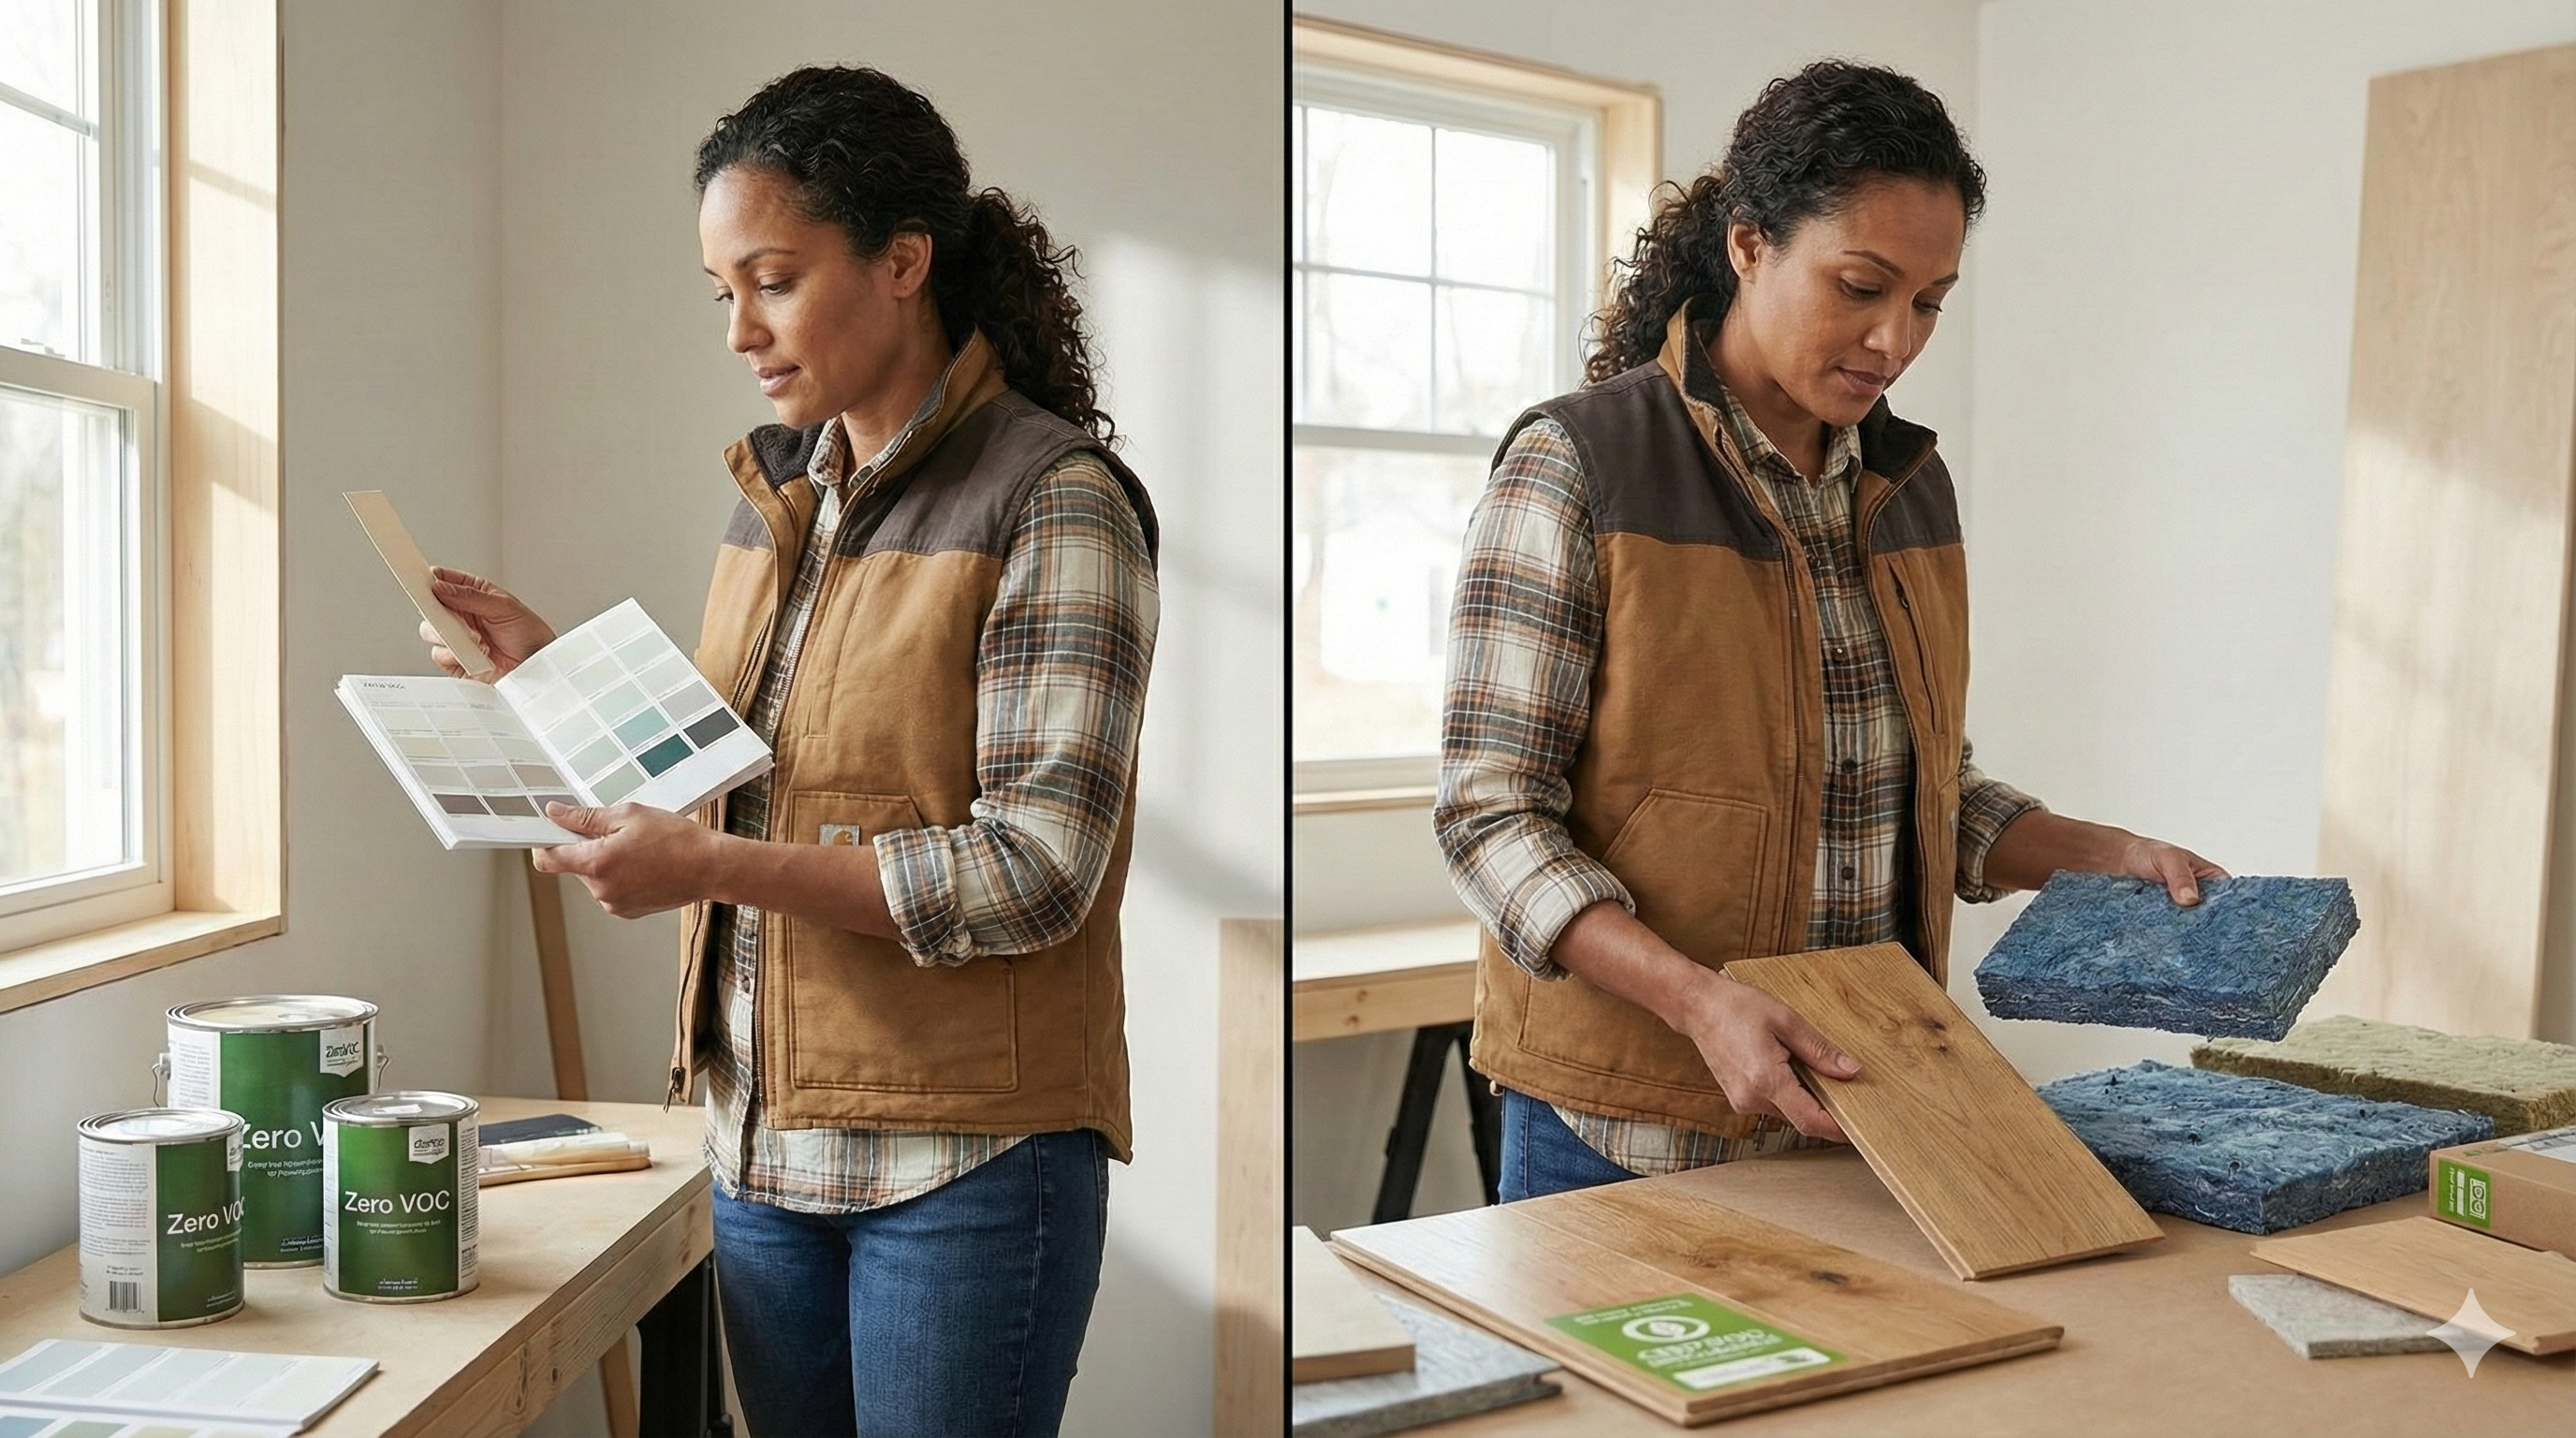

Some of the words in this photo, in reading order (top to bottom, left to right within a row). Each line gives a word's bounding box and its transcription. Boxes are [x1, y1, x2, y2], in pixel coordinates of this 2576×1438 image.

[344, 1191, 393, 1214] Zero
[400, 1189, 450, 1214] VOC
[167, 1213, 219, 1235] Zero
